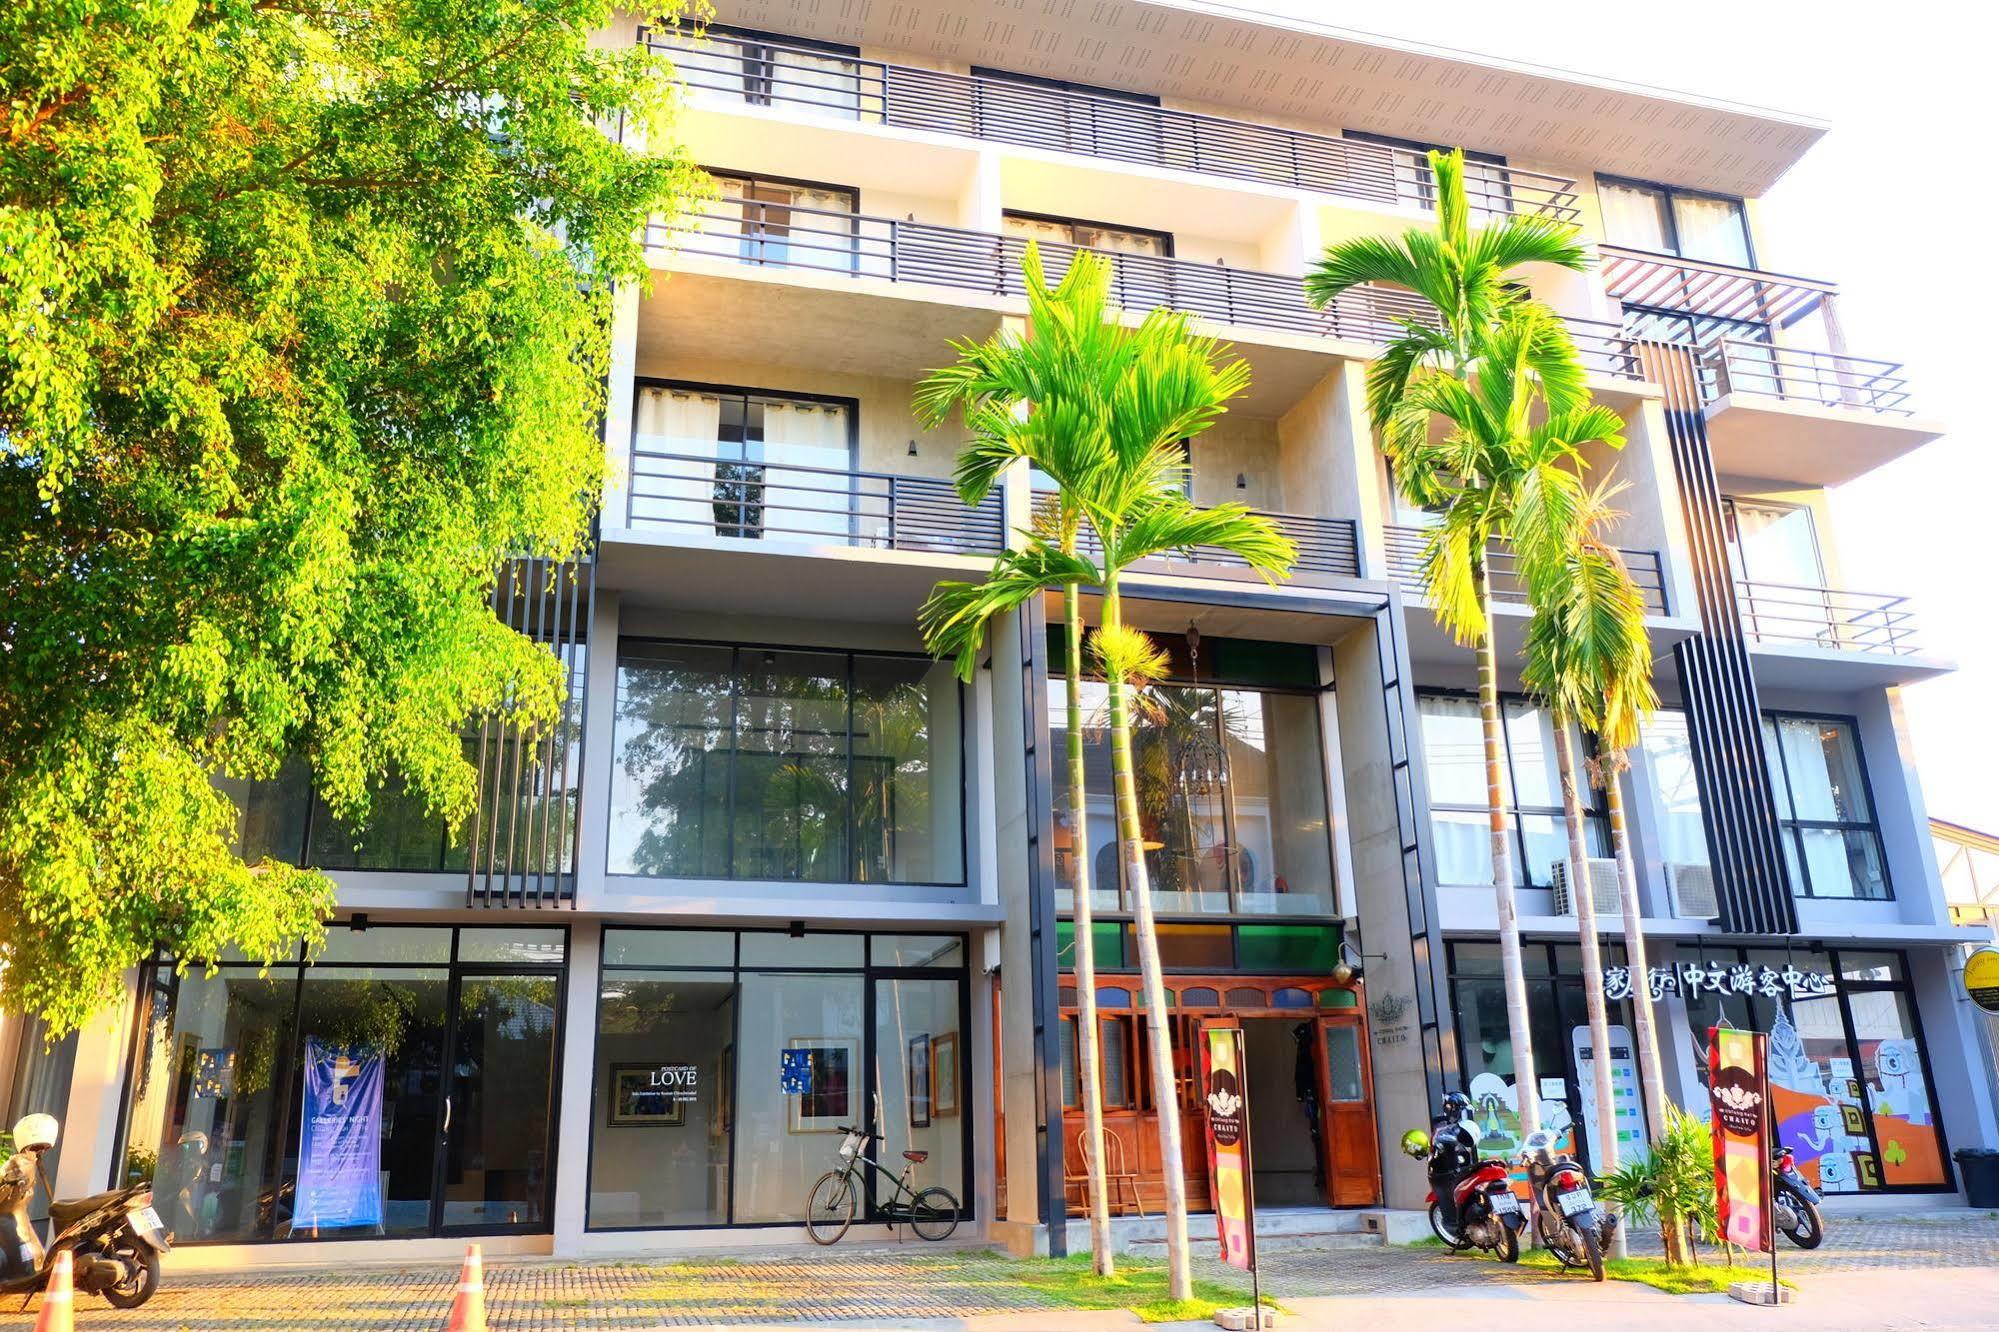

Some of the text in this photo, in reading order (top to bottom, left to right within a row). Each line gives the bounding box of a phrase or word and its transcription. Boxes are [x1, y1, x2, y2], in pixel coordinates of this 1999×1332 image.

[1683, 961, 1829, 999] 中文游客中心
[650, 1071, 697, 1086] LOVE
